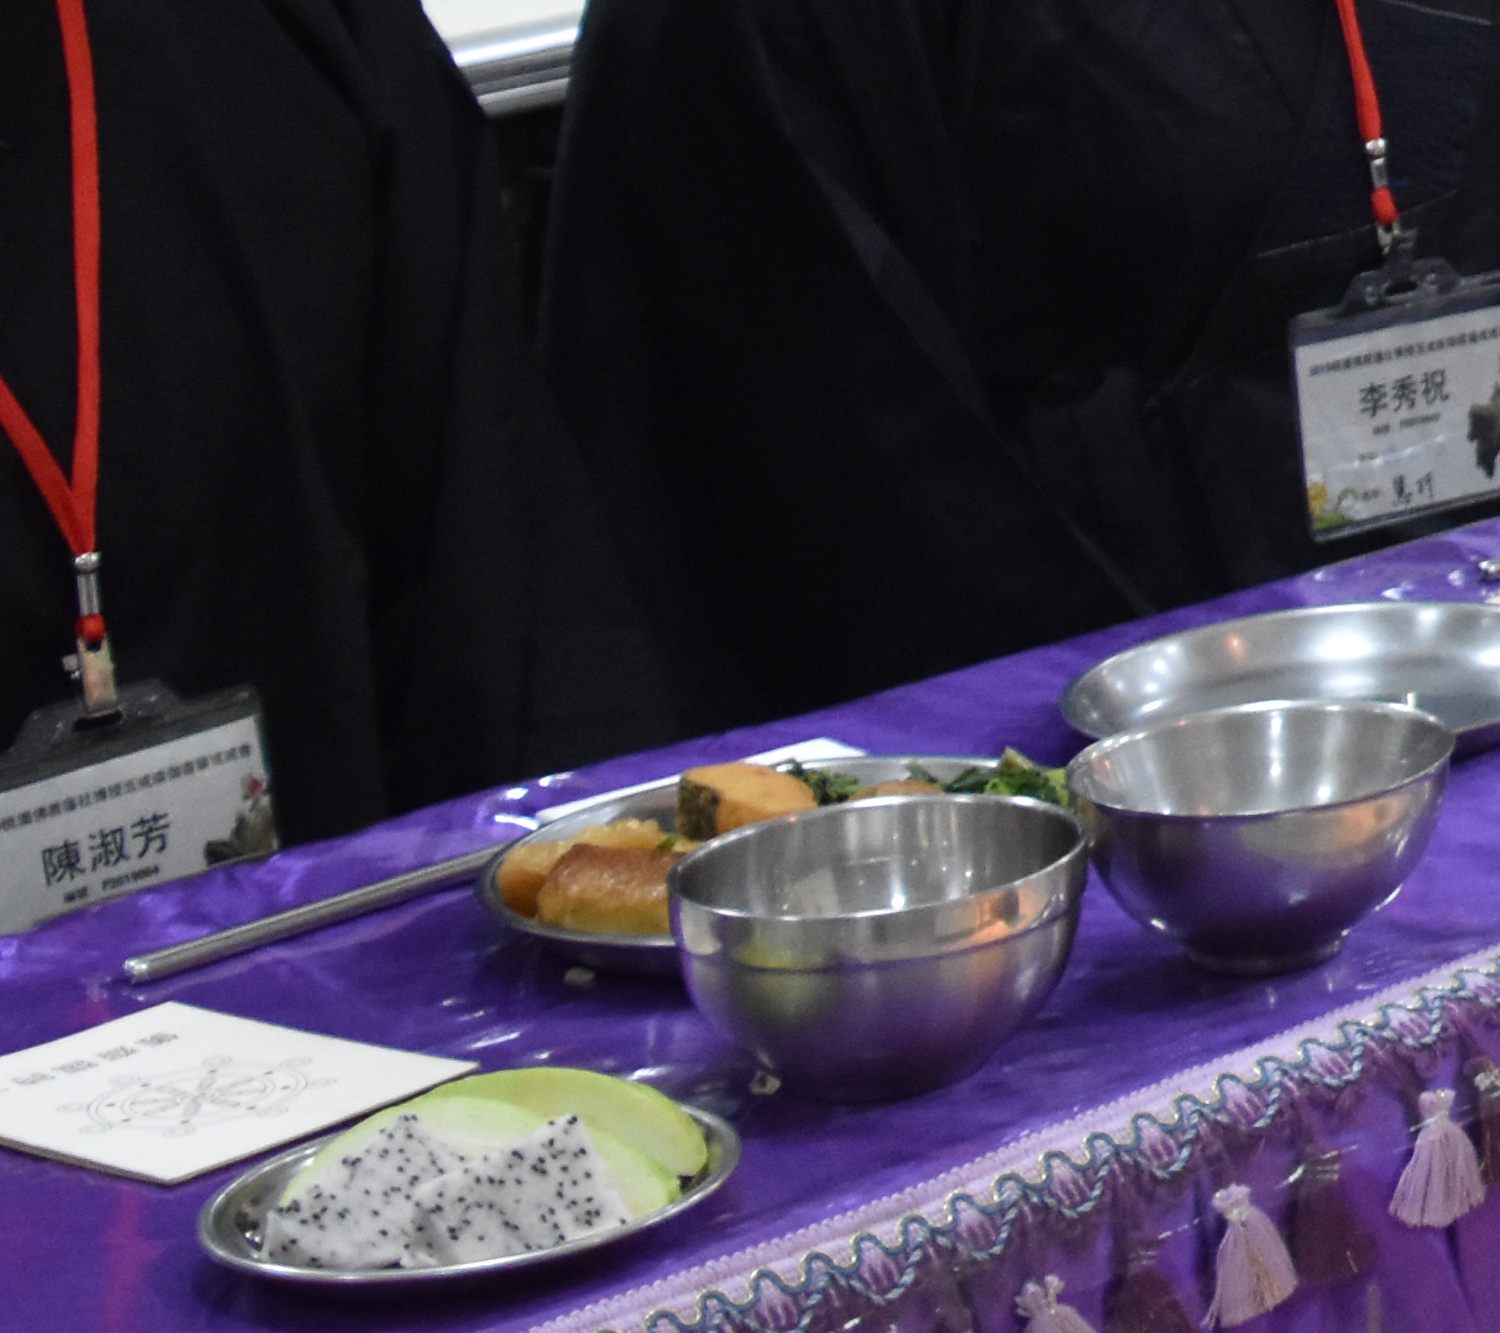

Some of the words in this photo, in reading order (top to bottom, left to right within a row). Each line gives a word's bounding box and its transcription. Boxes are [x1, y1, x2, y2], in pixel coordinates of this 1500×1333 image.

[1358, 369, 1449, 418] 李秀祝
[41, 813, 171, 885] 陳淑芳
